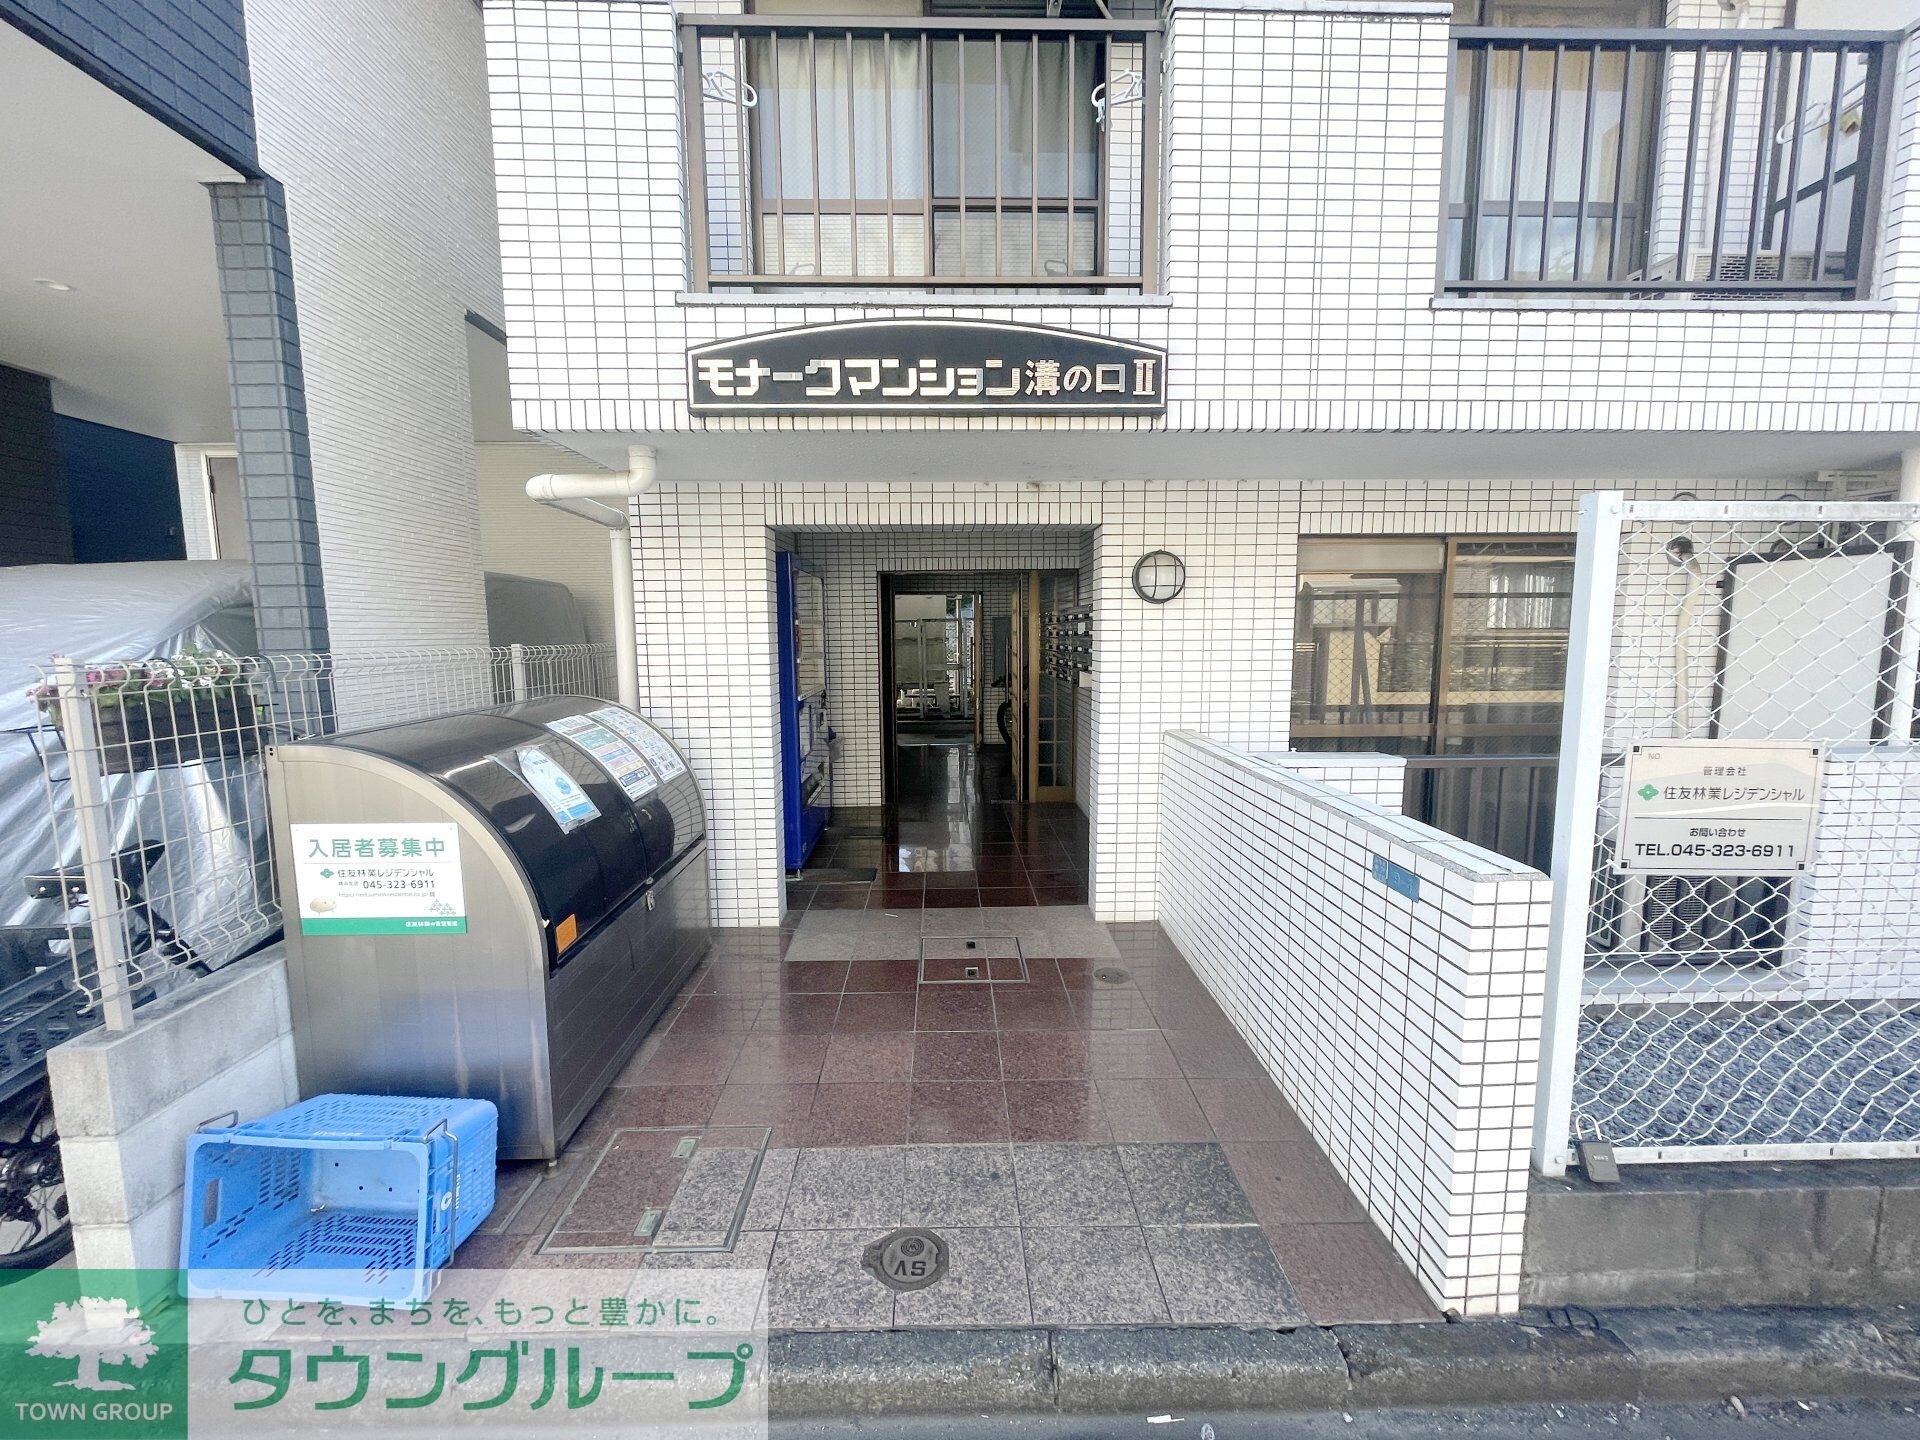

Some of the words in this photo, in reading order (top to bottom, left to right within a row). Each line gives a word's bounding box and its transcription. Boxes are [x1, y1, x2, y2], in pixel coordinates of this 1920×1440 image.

[1703, 766, 1747, 777] 管理会社
[1663, 785, 1805, 802] 住友林業レジデンシャル
[1689, 827, 1747, 838] お問い合わせ
[308, 837, 446, 858] 入居者募集中
[1634, 843, 1795, 858] TEL.045-323-6911
[337, 868, 435, 879] 住友林業レジデンシャル
[362, 879, 436, 889] 045-323-6911
[894, 1260, 927, 1277] SV
